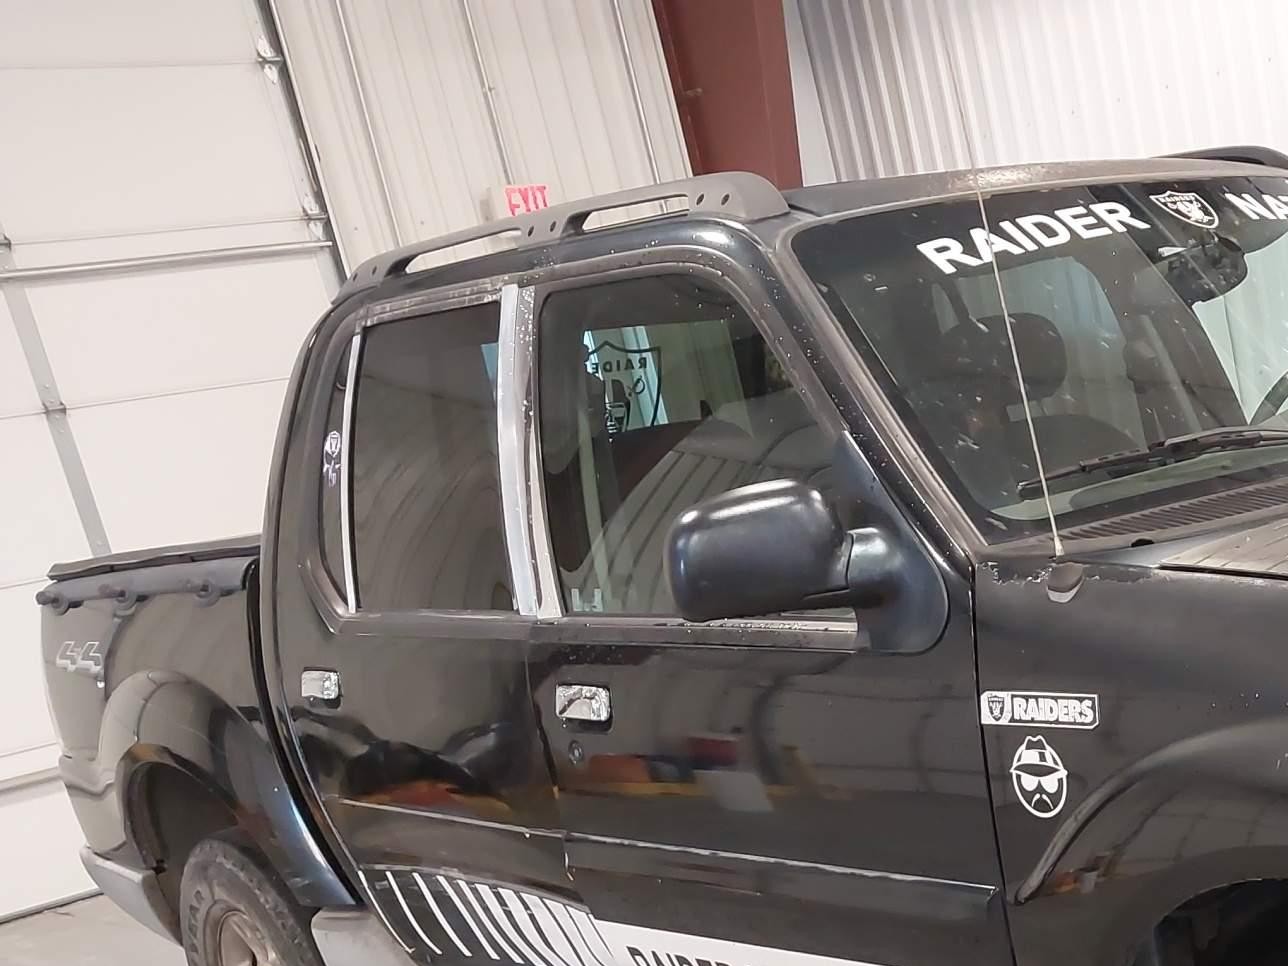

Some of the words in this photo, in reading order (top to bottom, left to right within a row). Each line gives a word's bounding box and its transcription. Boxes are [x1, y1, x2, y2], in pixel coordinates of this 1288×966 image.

[504, 185, 548, 217] EXIT
[915, 201, 1151, 275] RAIDER
[1012, 696, 1095, 724] RAIDERS
